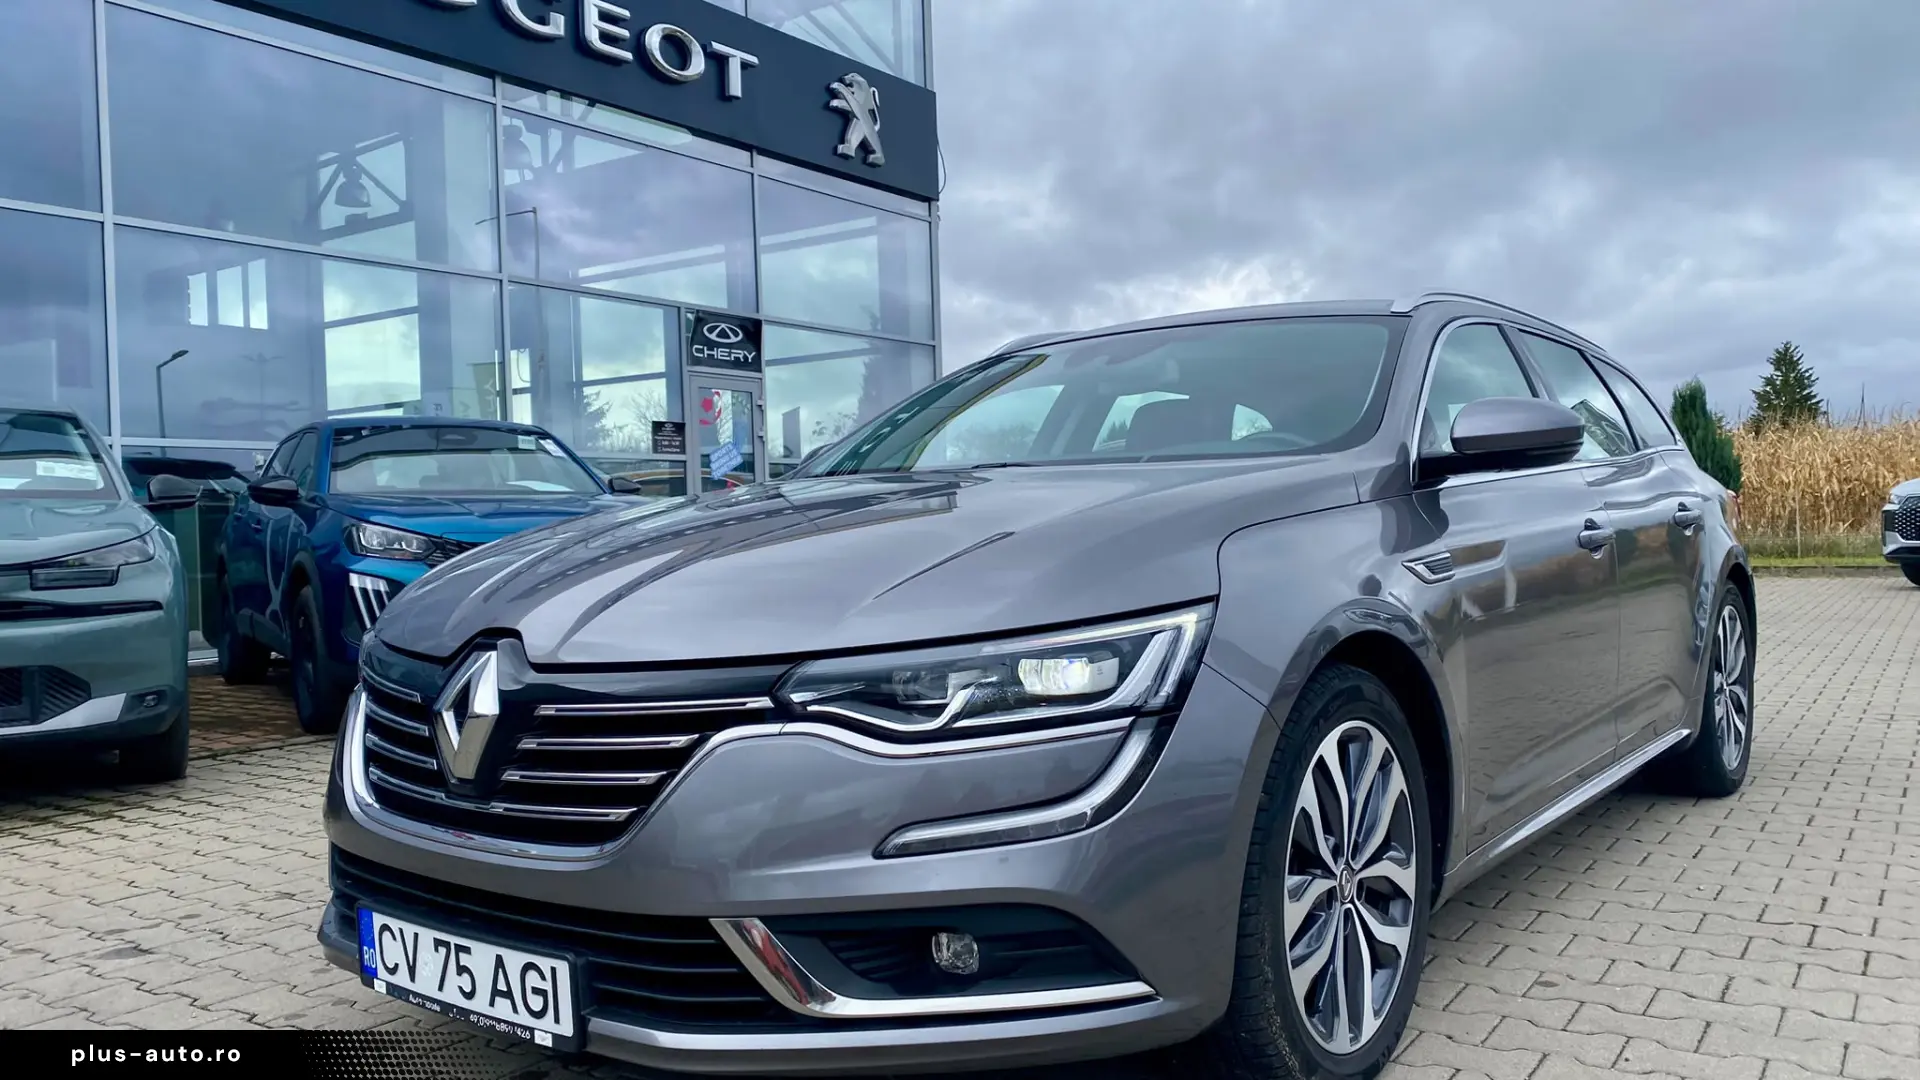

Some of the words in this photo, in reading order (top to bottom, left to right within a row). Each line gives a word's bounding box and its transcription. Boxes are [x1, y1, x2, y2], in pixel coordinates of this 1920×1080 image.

[418, 0, 760, 100] GEOT
[692, 344, 756, 363] CHERY
[363, 945, 377, 969] RO
[378, 922, 419, 984] CV
[433, 936, 477, 1001] 75
[488, 953, 561, 1025] AGI
